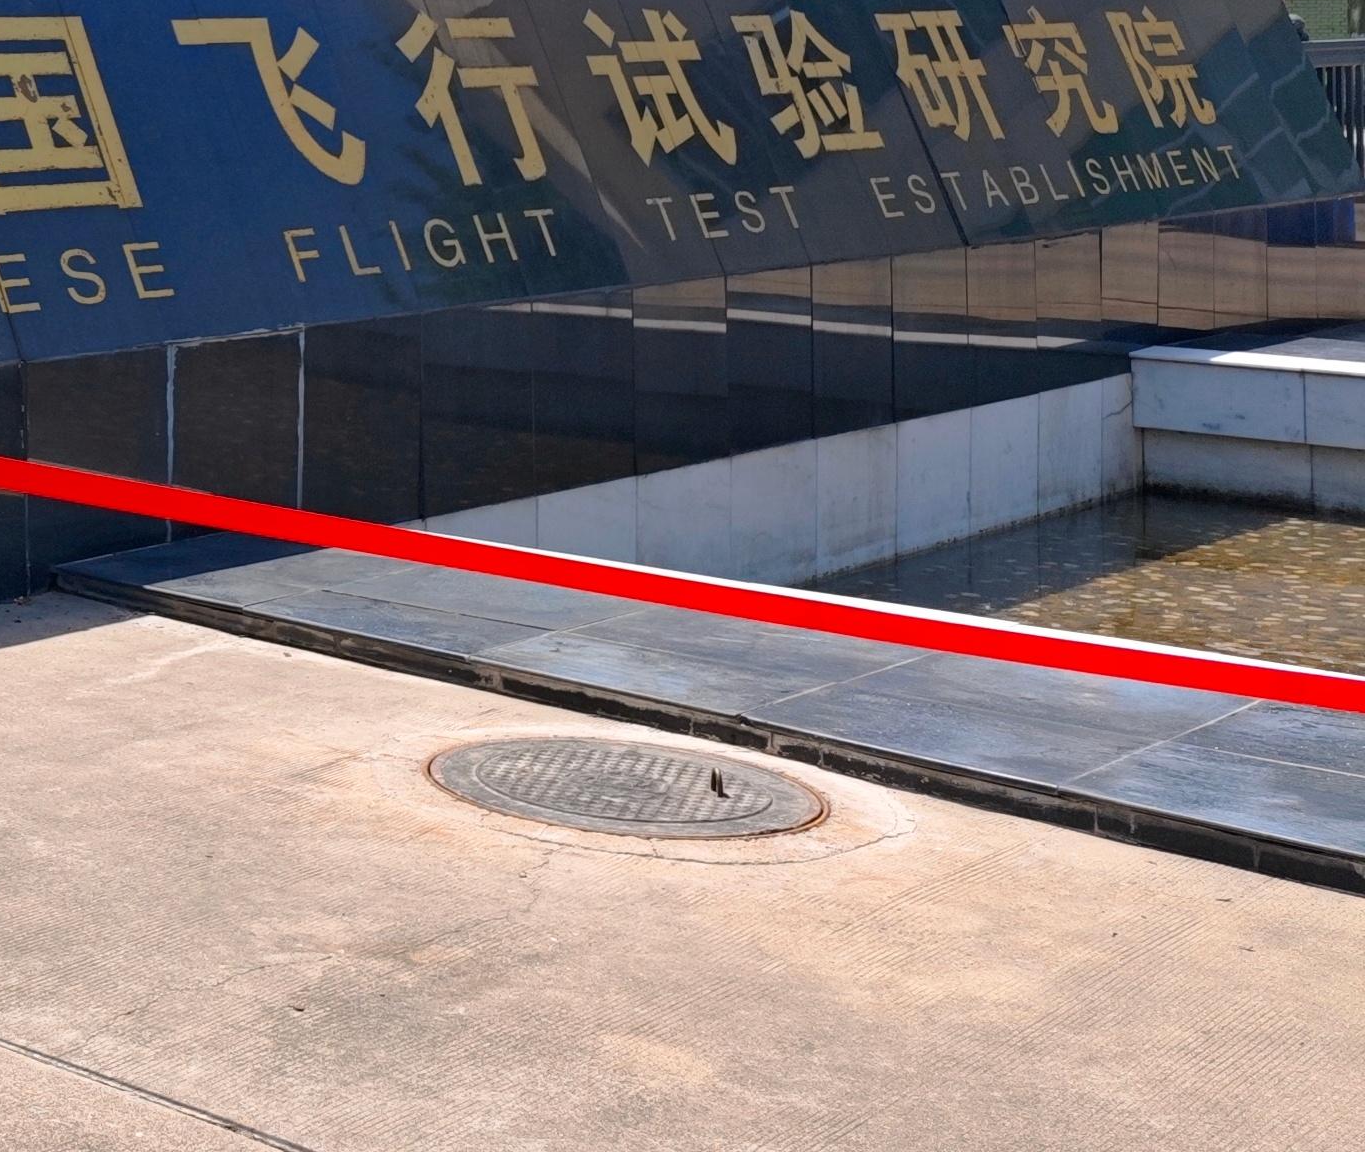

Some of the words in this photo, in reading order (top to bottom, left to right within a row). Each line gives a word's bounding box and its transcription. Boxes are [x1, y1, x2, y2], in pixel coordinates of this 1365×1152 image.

[282, 206, 559, 284] FLIGHT
[646, 184, 802, 243] TEST
[869, 143, 1248, 220] ESTABLISHMENT
